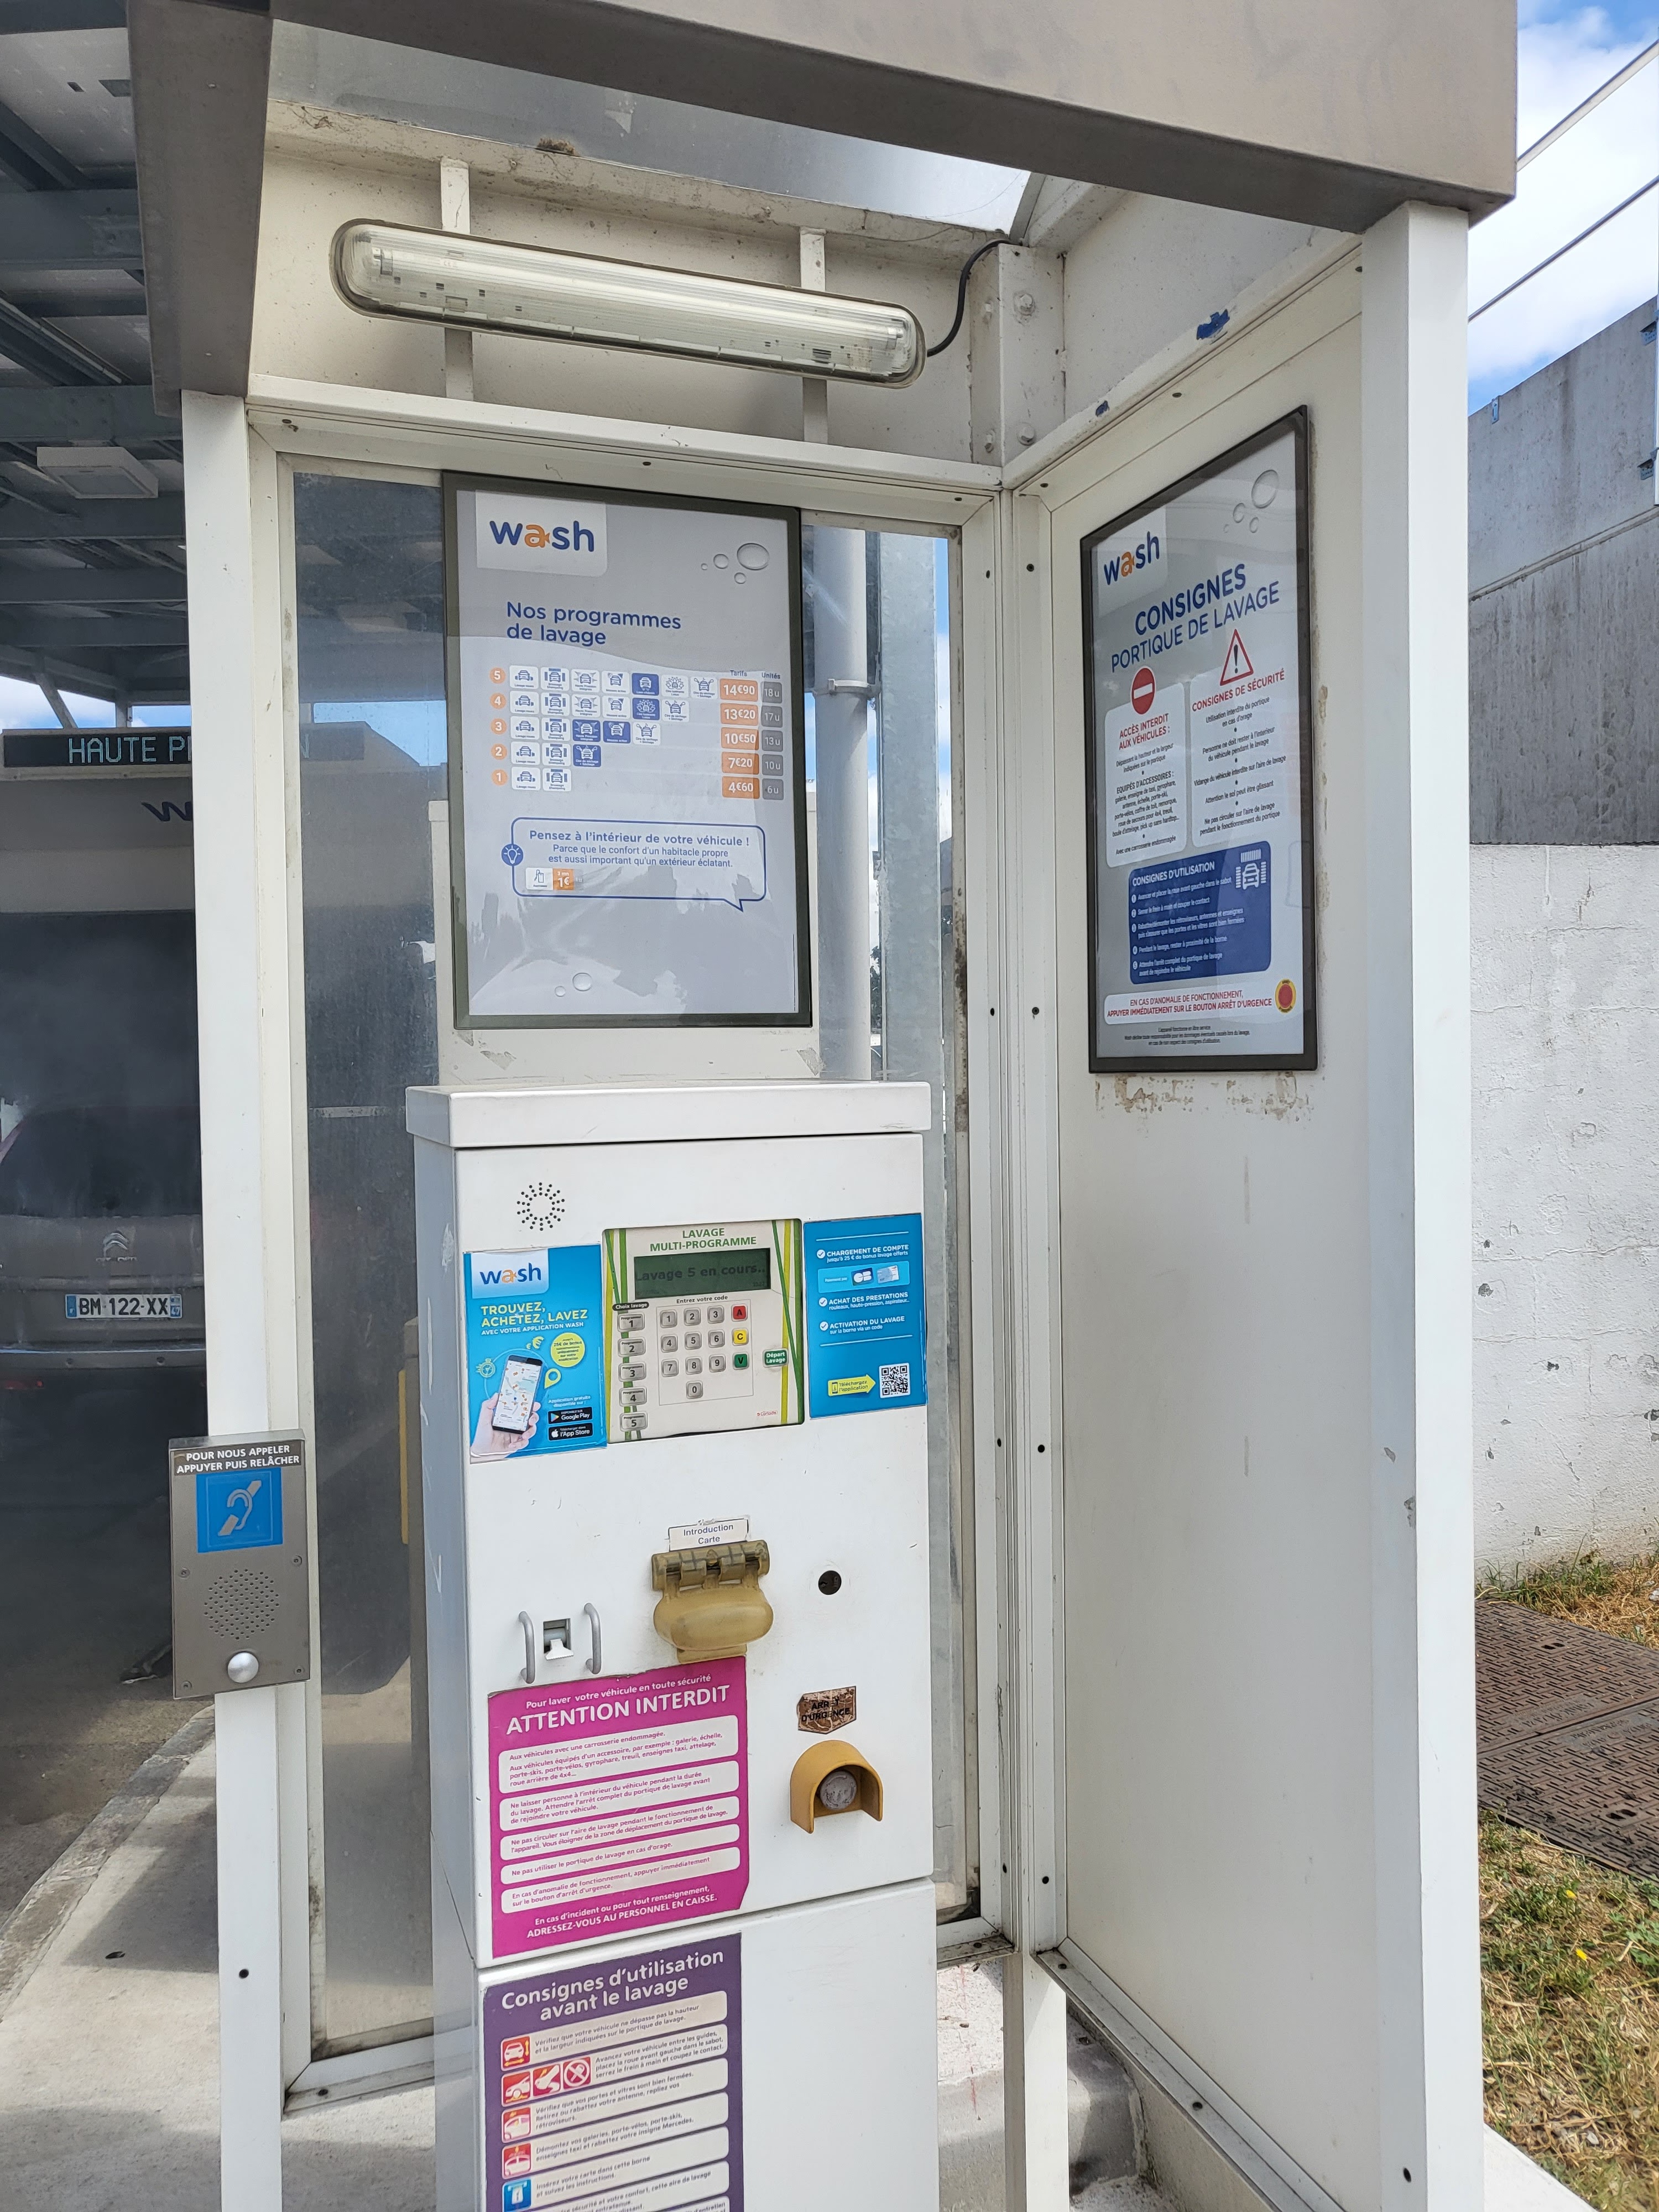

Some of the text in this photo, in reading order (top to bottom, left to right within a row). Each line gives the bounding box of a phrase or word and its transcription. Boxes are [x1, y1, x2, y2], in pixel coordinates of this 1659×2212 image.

[489, 520, 594, 552] wash
[1104, 531, 1159, 585] wash
[1135, 564, 1245, 635] CONSIGNES
[508, 602, 681, 633] Nos programmes
[1112, 581, 1279, 672] PORTIQUE DE LAVAGE
[507, 623, 606, 646] de lavage
[494, 671, 501, 680] 5
[724, 685, 754, 695] 14€90
[1192, 668, 1284, 712] CONSIGNES DE SÉCURITÉ
[494, 696, 501, 705] 4
[724, 709, 756, 720] 13€20
[495, 722, 502, 731] 3
[1120, 713, 1168, 738] ACCÈS INTERDIT
[725, 734, 756, 744] 10€50
[1119, 726, 1166, 750] AUX VÉHICULES
[69, 737, 156, 763] HAUTE
[496, 746, 503, 756] 2
[728, 757, 753, 768] 7€20
[729, 782, 753, 793] 4€60
[530, 831, 571, 840] Pensez
[575, 831, 581, 841] à
[646, 834, 659, 843] de
[664, 836, 692, 844] votre
[697, 836, 742, 846] véhicule
[581, 847, 597, 856] que
[662, 847, 699, 855] habitacle
[590, 855, 631, 865] important
[634, 857, 656, 866] qu'un
[558, 877, 571, 887] 1€
[1133, 872, 1167, 886] CONSIGNES
[1191, 990, 1243, 1003] FONCTIONNEMENT,
[1130, 1006, 1172, 1015] IMMÉDIATEMENT
[1193, 1003, 1216, 1011] BOUTON
[1218, 999, 1236, 1009] ARRÊT
[683, 1228, 724, 1238] LAVAGE
[650, 1237, 756, 1251] MULTI-PROGRAMME
[827, 1248, 871, 1256] CHARGEMENT
[480, 1263, 541, 1285] wash
[688, 1267, 695, 1277] 5
[481, 1302, 545, 1315] TROUVEZ,
[482, 1310, 587, 1327] ACHETEZ, LAVEZ
[830, 1320, 868, 1329] ACTIVATION
[187, 1446, 289, 1461] POUR NOUS APPELER
[177, 1456, 299, 1473] APPUYER PUIS RELÂCHER
[684, 1523, 733, 1536] Introduction
[549, 1695, 571, 1705] laver
[601, 1686, 637, 1697] véhicule
[652, 1679, 675, 1689] toute
[677, 1674, 711, 1686] sécurité
[507, 1683, 729, 1734] ATTENTION INTERDIT
[613, 1902, 631, 1911] pour
[651, 1886, 709, 1903] renseignement,
[528, 1894, 717, 1938] ADRESSEZ-VOUS AU PERSONNEL EN CAISSE.
[502, 1978, 603, 2012] Consignes
[541, 1978, 688, 2020] avant le lavage
